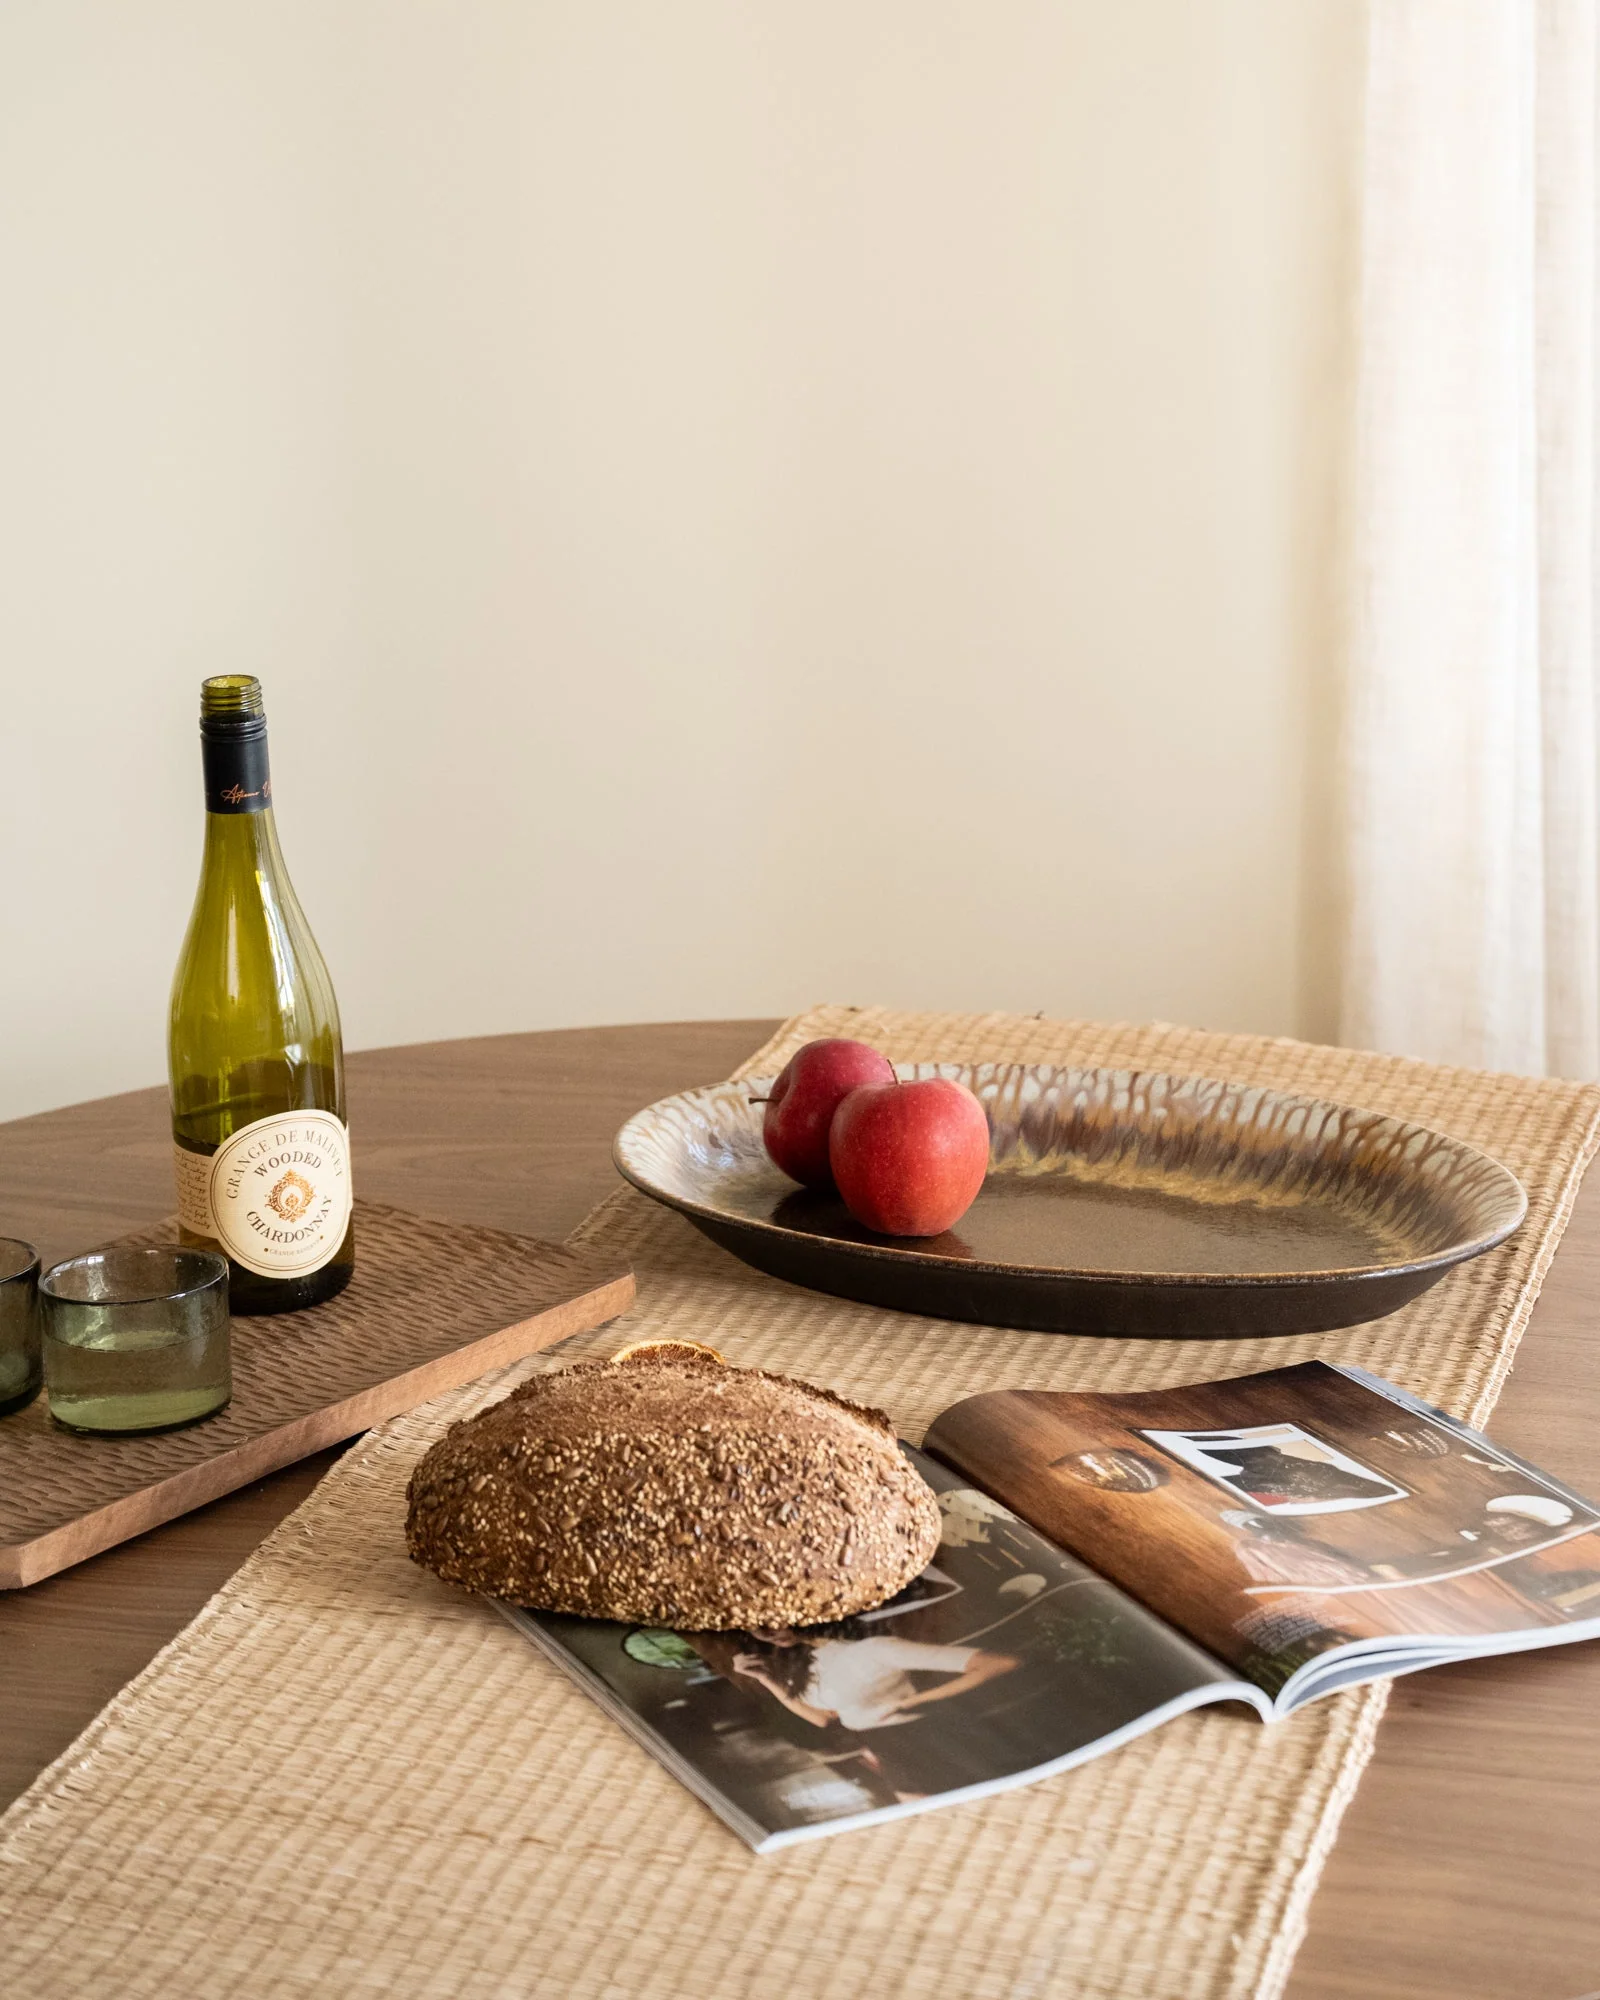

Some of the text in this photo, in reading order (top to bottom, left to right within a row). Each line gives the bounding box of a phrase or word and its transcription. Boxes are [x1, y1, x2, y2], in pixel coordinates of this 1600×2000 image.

[226, 1140, 271, 1199] GRANGE
[275, 1130, 298, 1147] DE
[253, 1150, 322, 1178] WOODED
[246, 1196, 332, 1244] CHARDONNAY
